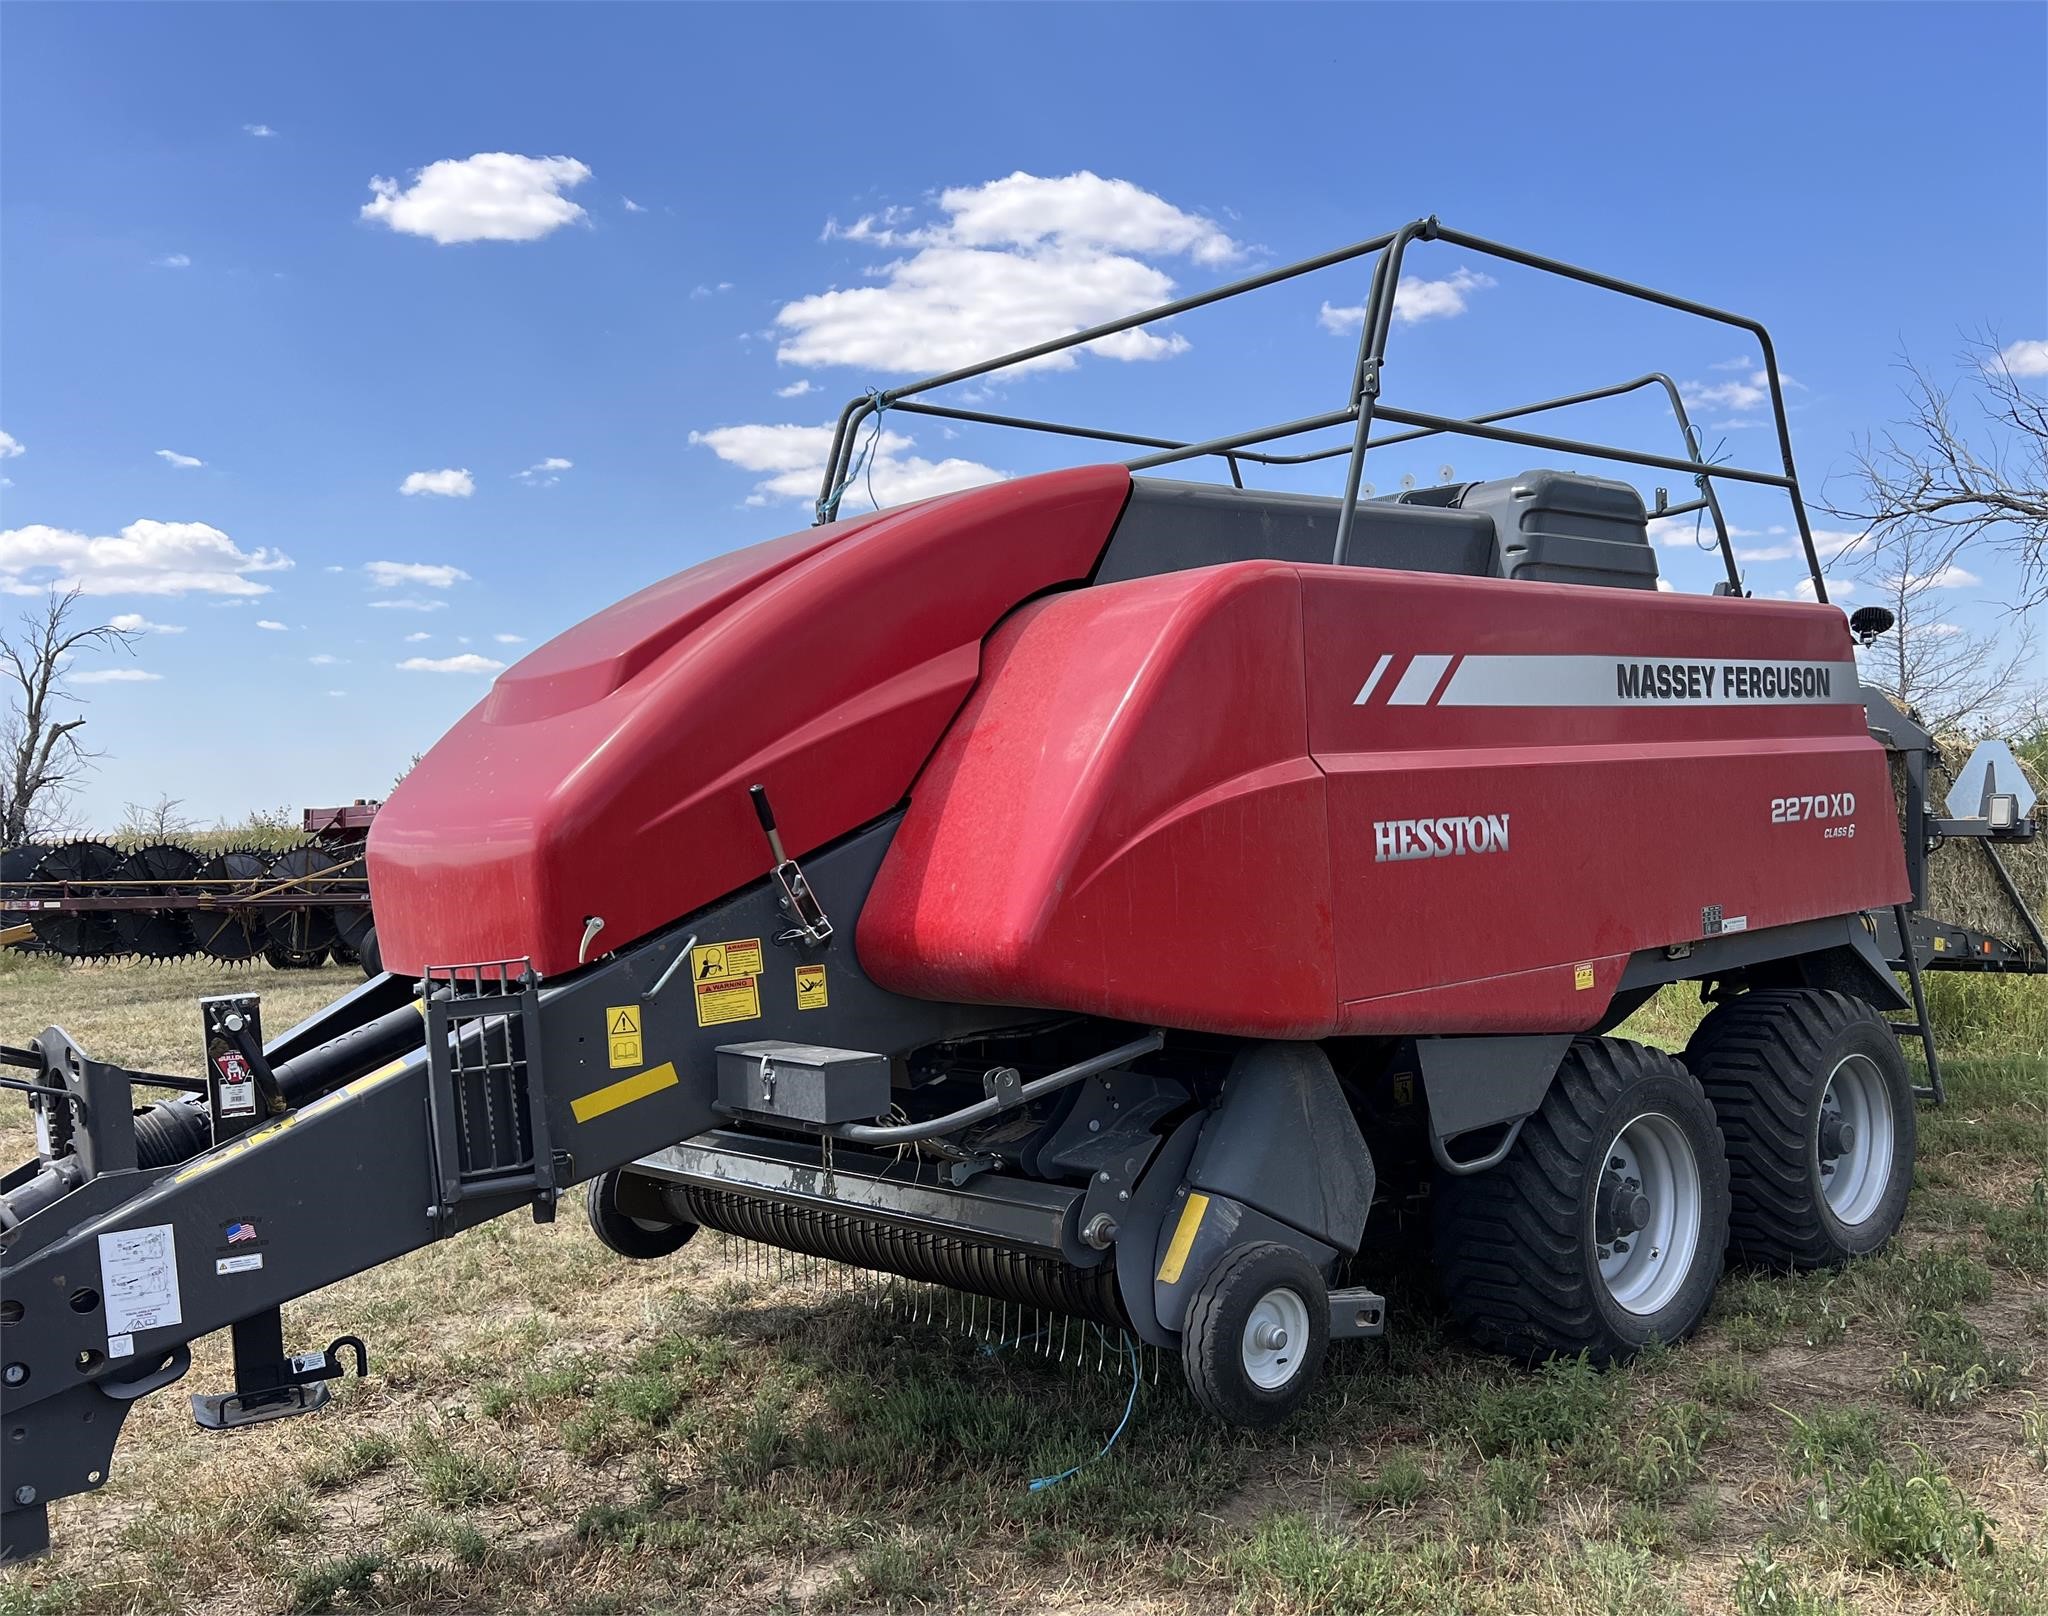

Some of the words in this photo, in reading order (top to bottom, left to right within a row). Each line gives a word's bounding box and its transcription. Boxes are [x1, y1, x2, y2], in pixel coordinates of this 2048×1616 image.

[1616, 663, 1716, 699] MASSEY
[1723, 666, 1831, 698] FERGUSON
[1373, 813, 1510, 863] HESSTON
[712, 980, 748, 990] WARNING
